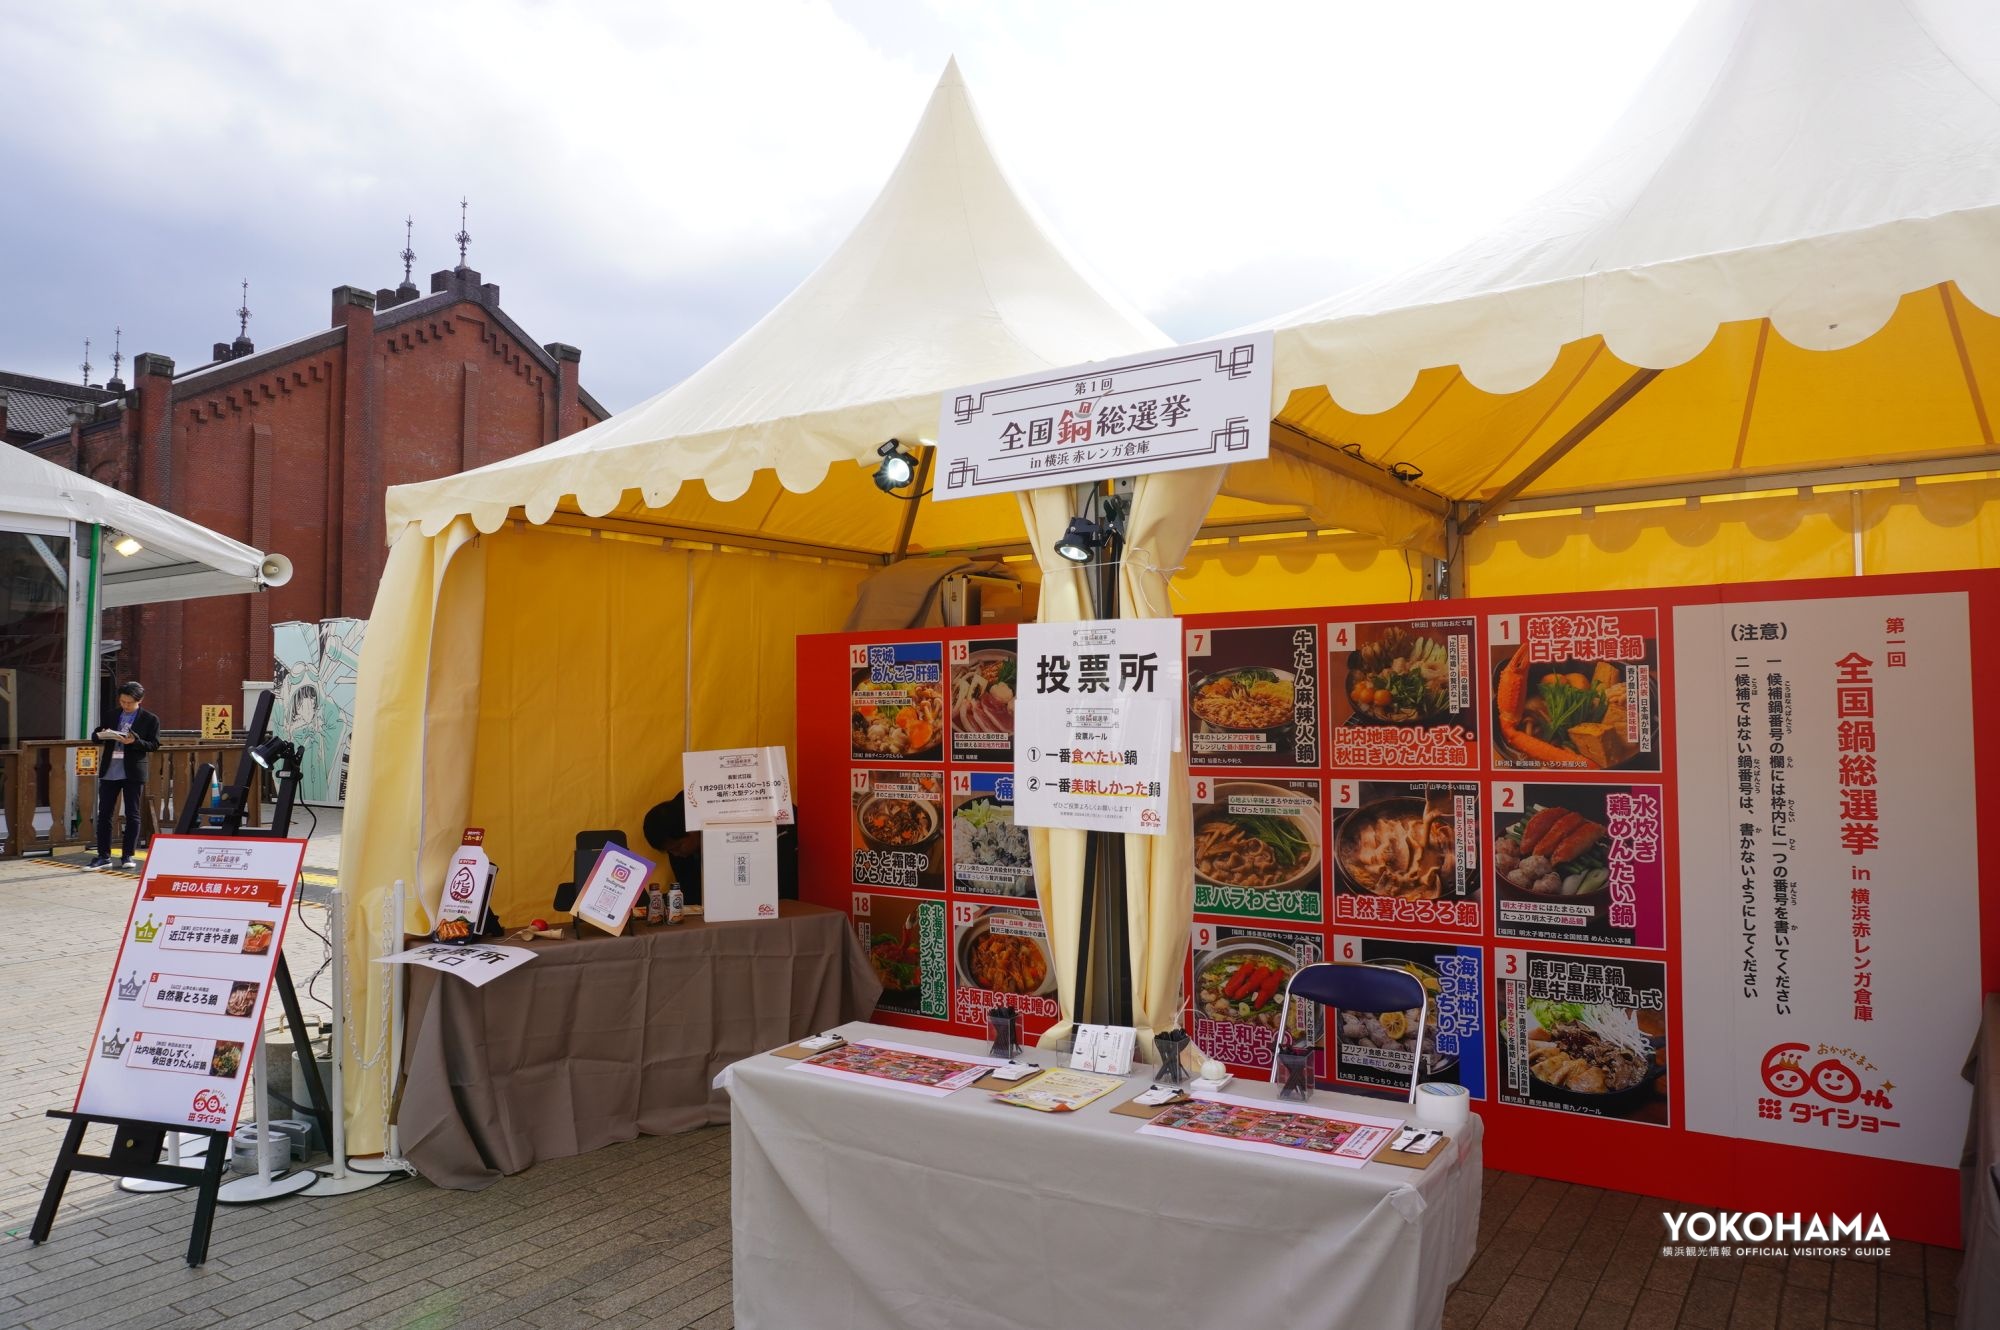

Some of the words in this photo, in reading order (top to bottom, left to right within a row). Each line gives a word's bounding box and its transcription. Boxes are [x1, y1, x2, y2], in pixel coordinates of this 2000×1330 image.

[1074, 377, 1113, 396] 第1回
[999, 394, 1191, 451] 全国鍋総選挙
[1030, 457, 1041, 469] in
[1336, 628, 1348, 646] 4
[1500, 620, 1510, 640] 1
[1527, 615, 1619, 641] 越後かに
[1731, 622, 1788, 642] （注意）
[1193, 634, 1204, 652] 7
[1529, 635, 1645, 663] 白子味噌鍋
[1886, 617, 1906, 668] 第一回
[852, 648, 866, 664] 16
[870, 646, 896, 665] 茨城
[952, 645, 967, 661] 13
[871, 664, 940, 683] あんこう肝鍋
[1036, 652, 1158, 694] 投票所
[1293, 629, 1316, 764] 牛たん麻辣火鍋
[1075, 732, 1108, 741] 投票ルール
[1045, 748, 1138, 766] 一番食べたい鍋
[1335, 745, 1468, 766] 秋田きりたんぽ鍋
[1835, 652, 1879, 855] 全国鍋総選挙
[853, 773, 868, 789] 17
[953, 776, 969, 791] 14
[995, 777, 1014, 801] 痛
[1045, 777, 1161, 798] 一番美味しかった鍋
[1197, 781, 1207, 799] 8
[1340, 784, 1351, 803] 5
[1502, 787, 1514, 808] 2
[1631, 793, 1659, 863] 水炊き
[737, 856, 747, 883] 投票箱
[855, 849, 929, 872] かもと霜降り
[1606, 793, 1637, 928] 鶏めんたい鍋
[855, 867, 919, 887] ひらたけ鍋
[1852, 866, 1871, 881] in
[171, 880, 223, 895] 昨日の人気鍋
[224, 882, 259, 896] トップ3
[854, 896, 869, 912] 18
[1194, 884, 1321, 916] 豚バラわさび鍋
[1502, 902, 1591, 915] 明太子好きにはたまらない
[955, 906, 971, 922] 15
[1336, 894, 1480, 928] 自然薯とろろ鍋
[1502, 912, 1585, 926] たっぷり明太子の絶品鍋
[168, 930, 239, 945] 近江牛すきやき鍋
[1199, 928, 1209, 945] 9
[1343, 942, 1354, 959] 6
[1851, 888, 1874, 1022] 横浜赤レンガ倉庫
[1505, 954, 1518, 974] 3
[1529, 959, 1624, 987] 鹿児島黒鍋
[157, 990, 218, 1007] 自然薯とろろ鍋
[956, 986, 1057, 1018] 大阪風3種味噌の
[1456, 954, 1479, 1038] 海鮮柚子
[1530, 978, 1664, 1010] 黒牛黒豚「極」式
[1434, 954, 1460, 1055] てっちり鍋
[1343, 1055, 1414, 1071] ふぐと昆布だしのあっさ
[1817, 1042, 1879, 1071] おかげさまで
[1789, 1102, 1900, 1133] ダイショー
